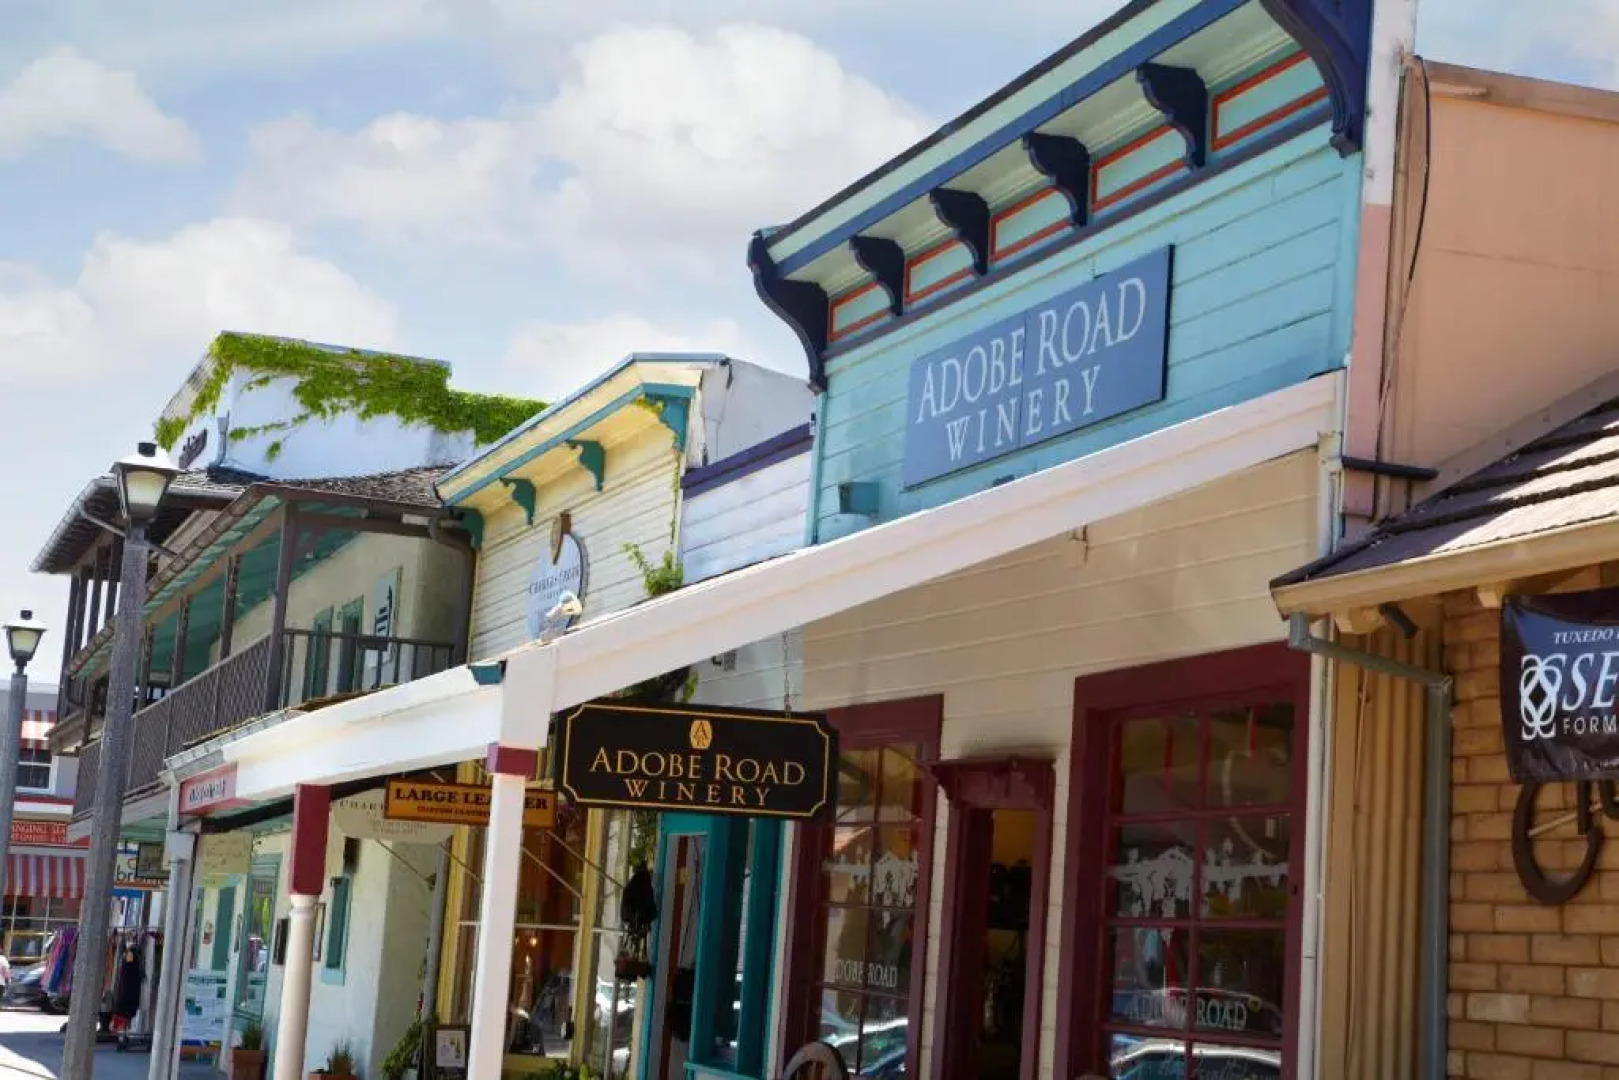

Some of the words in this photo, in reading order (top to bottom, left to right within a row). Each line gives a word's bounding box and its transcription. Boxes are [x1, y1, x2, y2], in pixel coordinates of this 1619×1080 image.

[915, 326, 1026, 425] ADOBE
[1035, 277, 1147, 377] ROAD
[944, 364, 1101, 463] WINERY
[1553, 628, 1614, 645] TUXEDO
[589, 746, 702, 780] ADOBE
[714, 754, 806, 786] ROAD
[394, 787, 457, 804] LARGE
[464, 791, 548, 811] LEER
[623, 777, 771, 807] WINERY
[867, 964, 898, 988] ROAD
[1196, 997, 1248, 1031] ROAD
